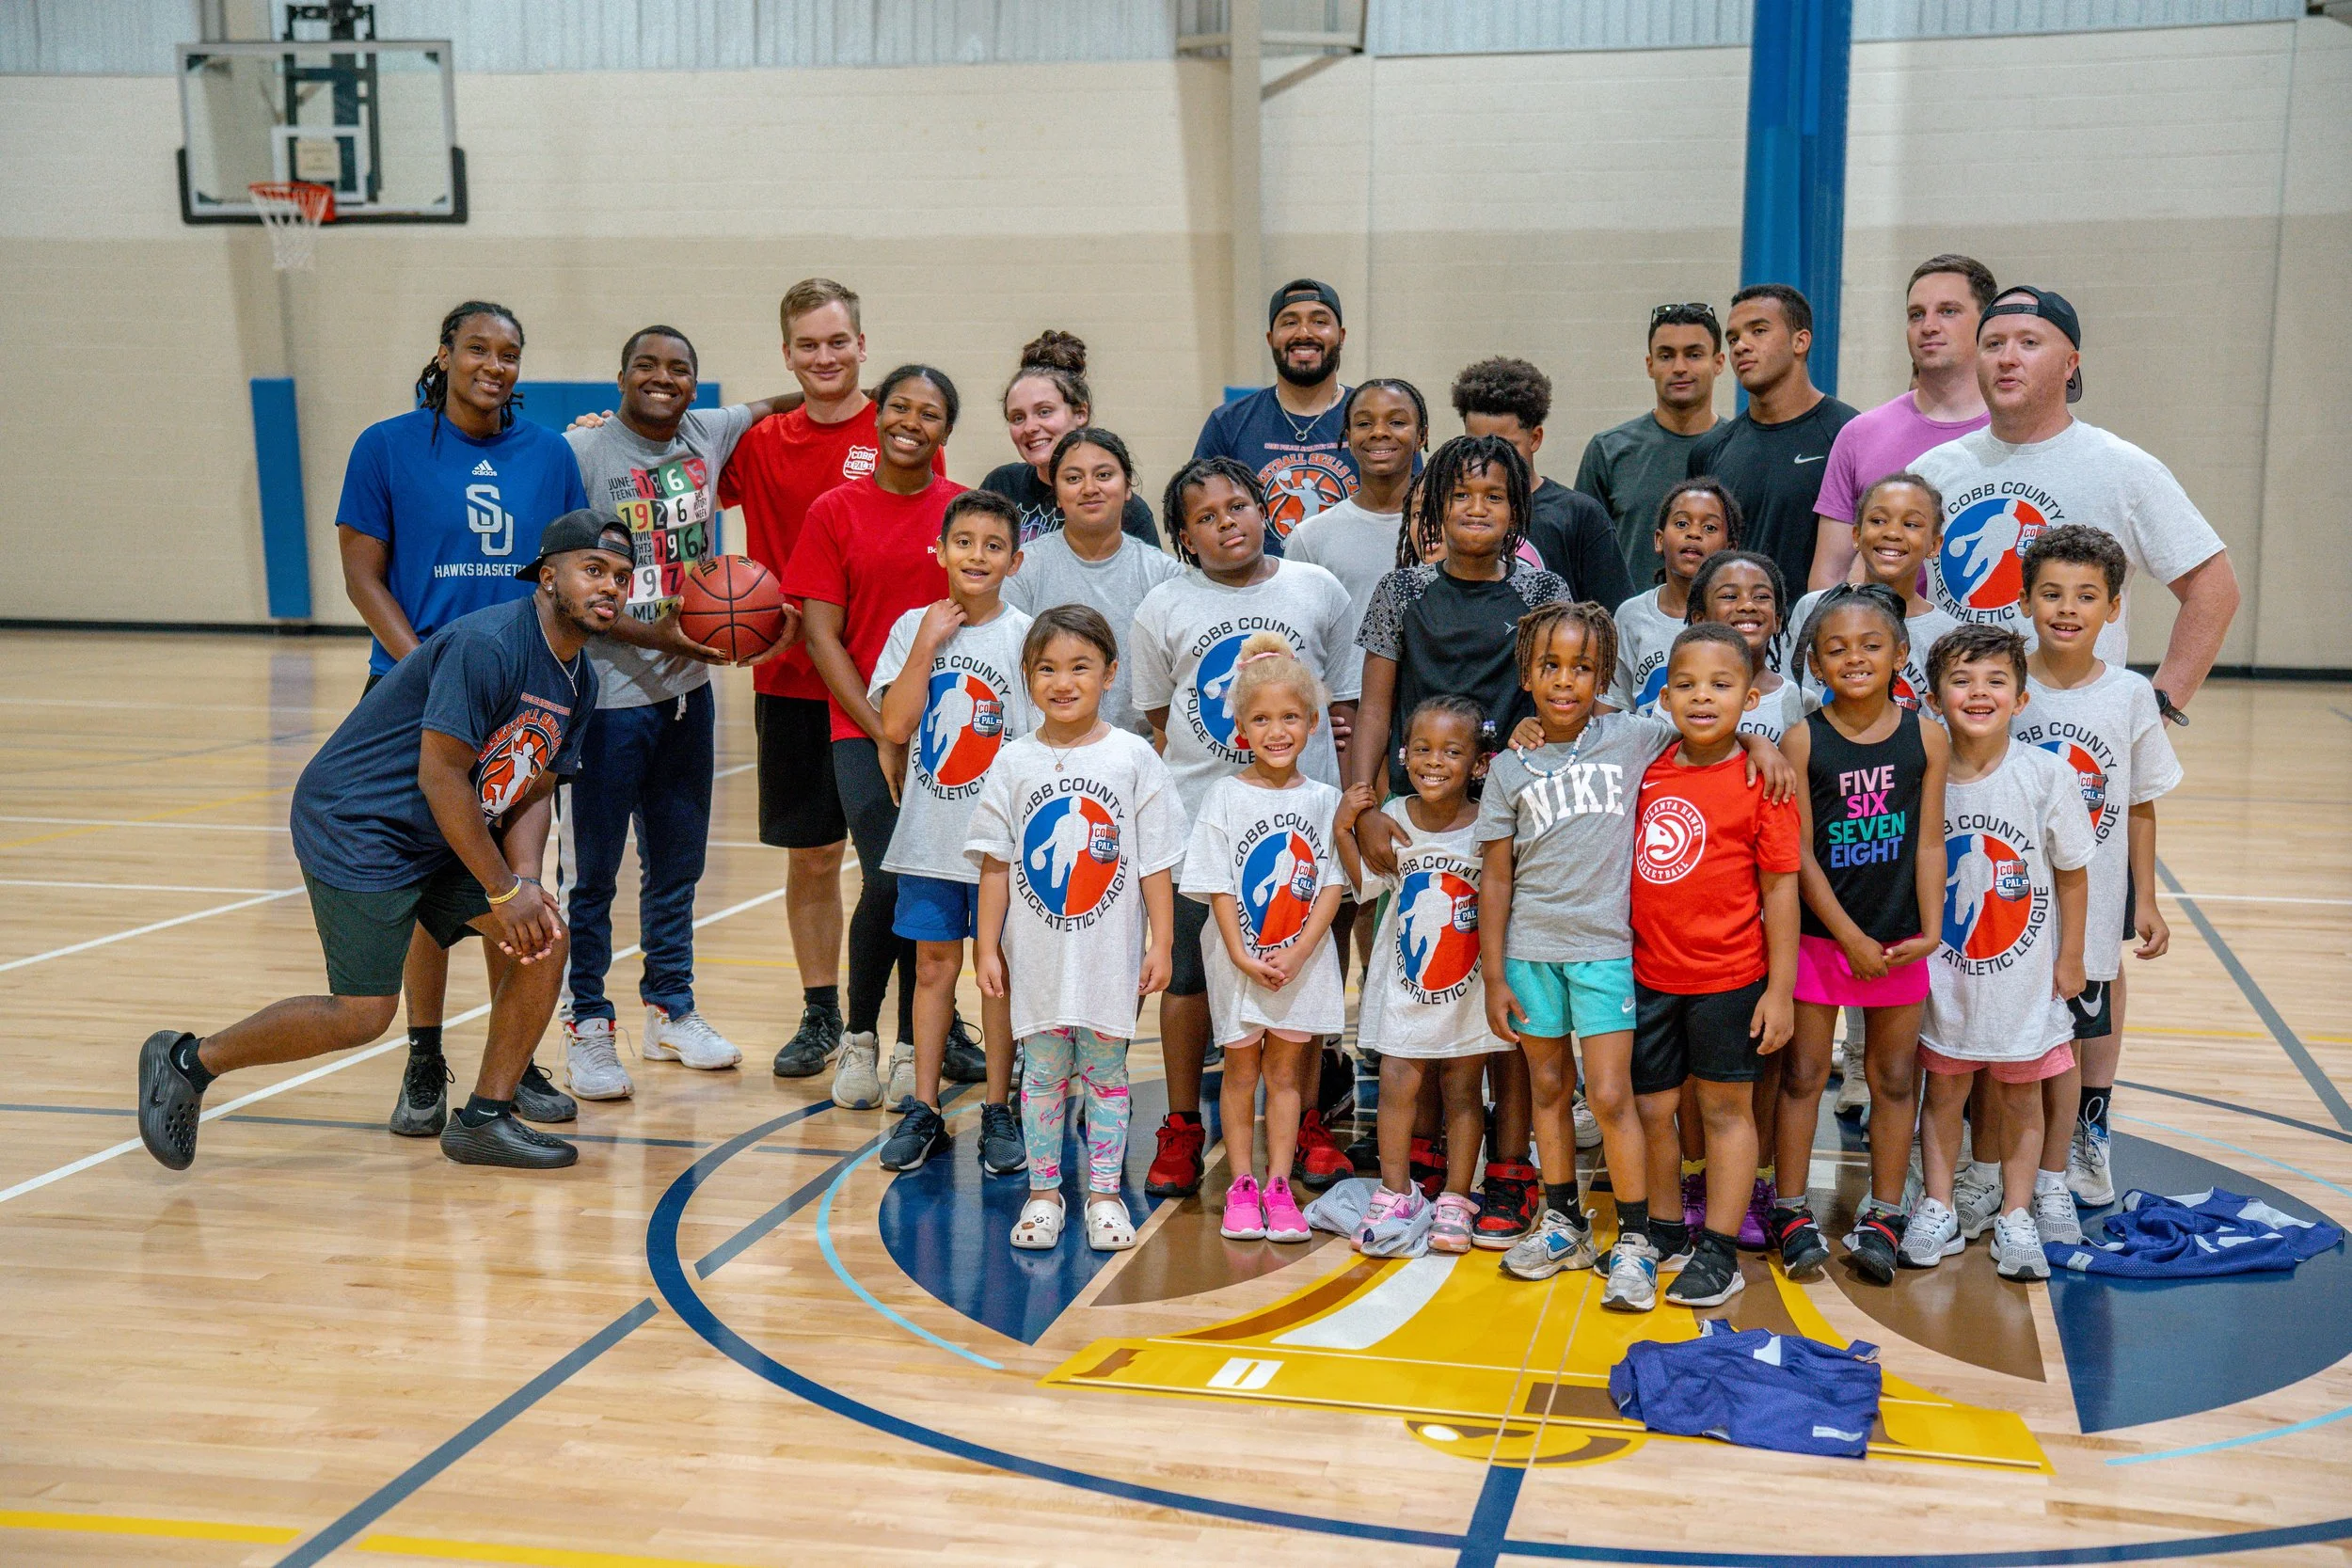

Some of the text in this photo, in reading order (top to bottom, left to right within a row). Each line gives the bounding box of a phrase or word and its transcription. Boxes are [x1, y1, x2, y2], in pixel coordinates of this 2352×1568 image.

[852, 461, 867, 469] PAL
[608, 477, 636, 490] JUNE-
[611, 487, 643, 500] TEENTH
[621, 498, 688, 531] 1926
[1947, 481, 2065, 521] COBB COUNTY
[466, 483, 514, 556] SU
[632, 531, 651, 542] IVIL
[434, 563, 526, 578] HAWKS BASKET
[628, 568, 678, 599] 197
[1931, 557, 2015, 625] OLICE ATHLETIC
[1192, 617, 1306, 657] COBB COUNTY
[950, 656, 1011, 696] COUNTY
[1635, 650, 1665, 685] COBB
[1901, 661, 1928, 694] NTY
[978, 705, 1000, 714] COBB
[981, 716, 994, 725] PAL
[1187, 688, 1256, 764] POLICE ATHLE
[1740, 722, 1781, 743] COU
[2016, 722, 2118, 769] BB COUNTY
[917, 773, 980, 800] ATHLETIC
[1839, 764, 1895, 797] FIVE
[2080, 777, 2104, 788] COBB
[2082, 790, 2096, 800] PAL
[1059, 778, 1124, 819] COUNTY
[1521, 763, 1625, 837] NIKE
[1847, 790, 1888, 819] SIX
[1094, 829, 1117, 840] COBB
[1644, 801, 1702, 836] ATLANTA HAWKS
[1828, 811, 1905, 844] SEVEN
[1958, 814, 2035, 854] COUNTY
[2095, 803, 2121, 847] GUE
[1098, 841, 1112, 850] PAL
[1234, 813, 1328, 867] COBB COUNTY
[1831, 835, 1903, 868] EIGHT
[1400, 856, 1482, 882] OBB COUNT
[1638, 853, 1689, 879] BASKETBALL
[2000, 864, 2024, 876] COBB
[1014, 854, 1129, 932] POLICE ATETIC LEAGUE
[1299, 879, 1311, 890] PAL
[2005, 879, 2021, 887] PAL
[1462, 911, 1476, 921] PAL
[1941, 886, 2049, 976] ATHLETIC LEAGUE
[1395, 927, 1467, 1005] OLICE ATHLETIC
